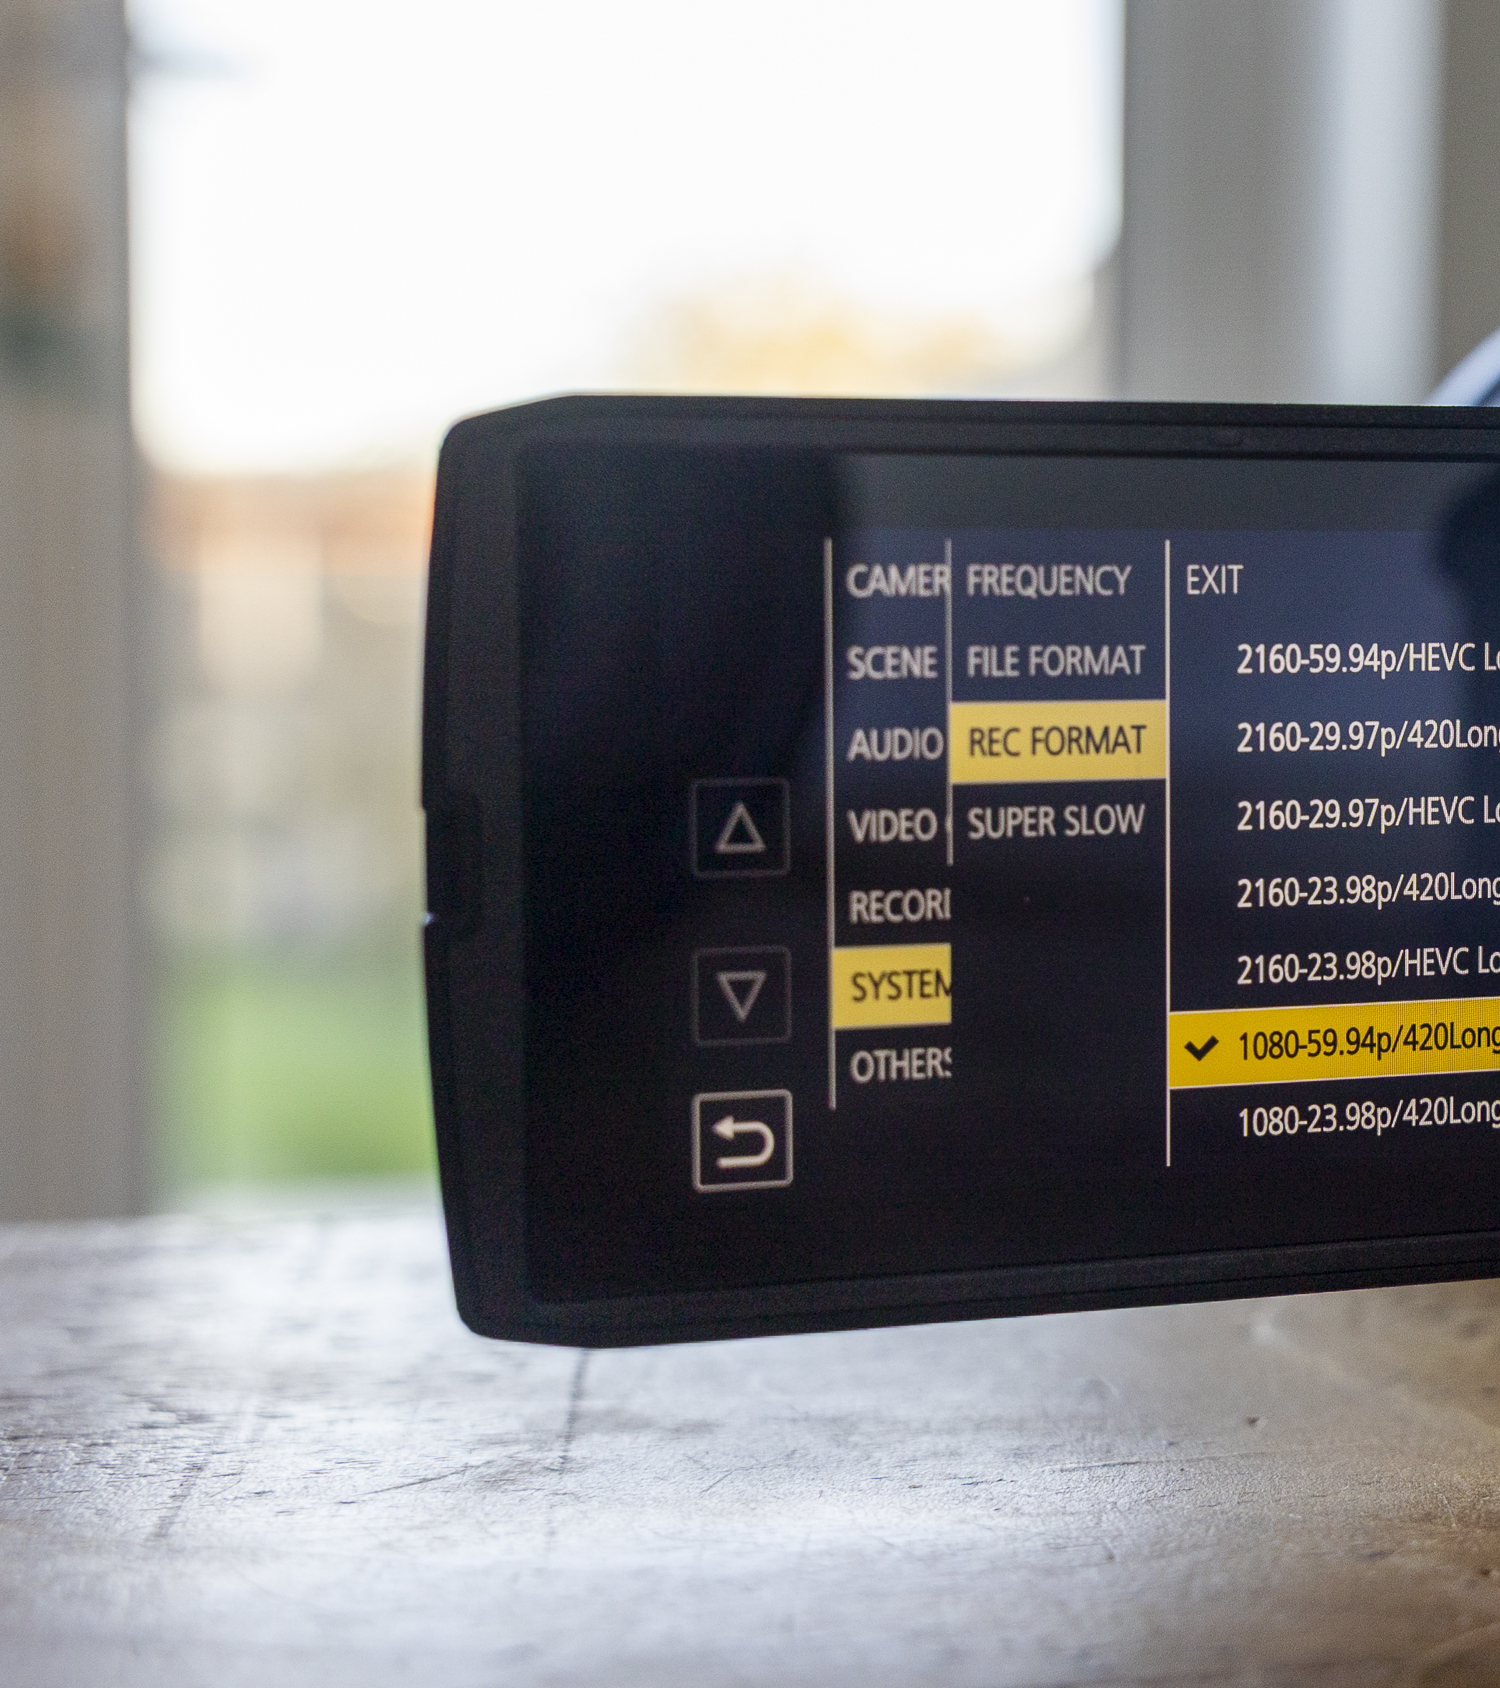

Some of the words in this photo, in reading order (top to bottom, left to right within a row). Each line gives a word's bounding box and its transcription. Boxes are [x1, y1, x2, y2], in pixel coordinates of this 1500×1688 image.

[966, 564, 1133, 599] FREQUENCY
[1186, 564, 1245, 595] EXIT
[846, 645, 938, 680] SCENE
[966, 645, 1020, 678] FILE
[1028, 644, 1147, 677] FORMAT
[1237, 641, 1476, 680] 2160-59.94p/HEVC
[846, 726, 945, 762] AUDIO
[968, 727, 1022, 758] REC
[1030, 724, 1147, 756] FORMAT
[847, 808, 938, 843] VIDEO
[967, 806, 1057, 840] SUPER
[1063, 804, 1146, 836] SLOW
[1237, 795, 1476, 834] 2160-29.97p/HEVC
[850, 887, 951, 924] RECOR
[1237, 946, 1470, 985] 2160-23.98p/HEVC
